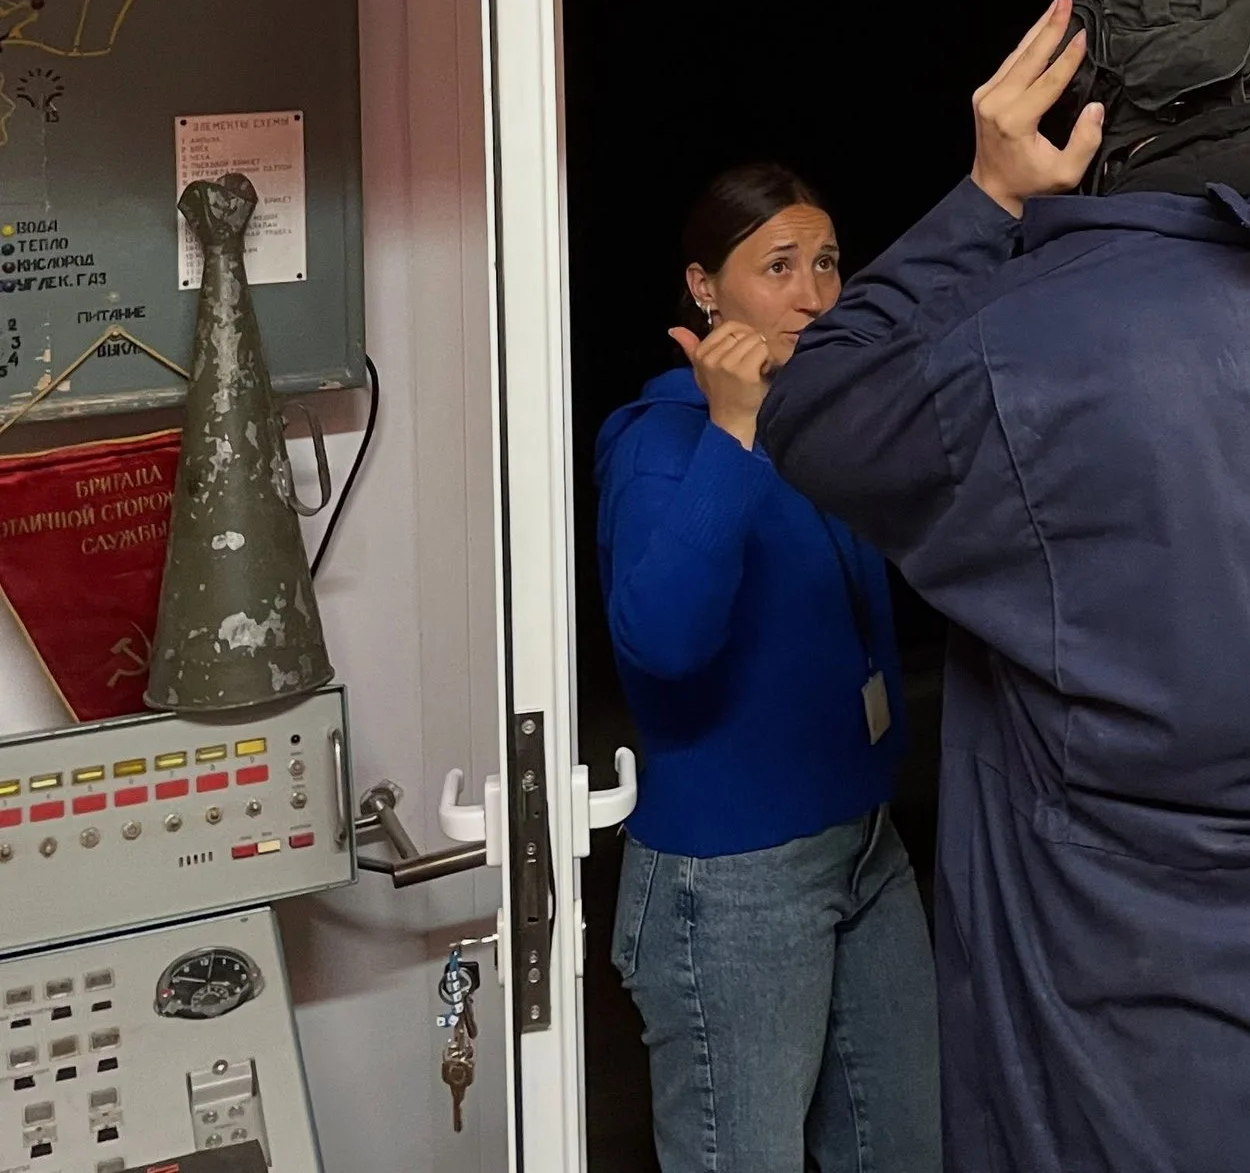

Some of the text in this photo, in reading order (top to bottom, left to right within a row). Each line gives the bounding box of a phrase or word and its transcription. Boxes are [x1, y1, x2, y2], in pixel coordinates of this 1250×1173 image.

[16, 219, 58, 234] ВОДА
[18, 237, 69, 253] ТЕПЛО
[17, 253, 95, 272] КИСЛОРОД
[77, 306, 146, 324] ПИТАНИЕ
[75, 465, 163, 498] БРИГАДА
